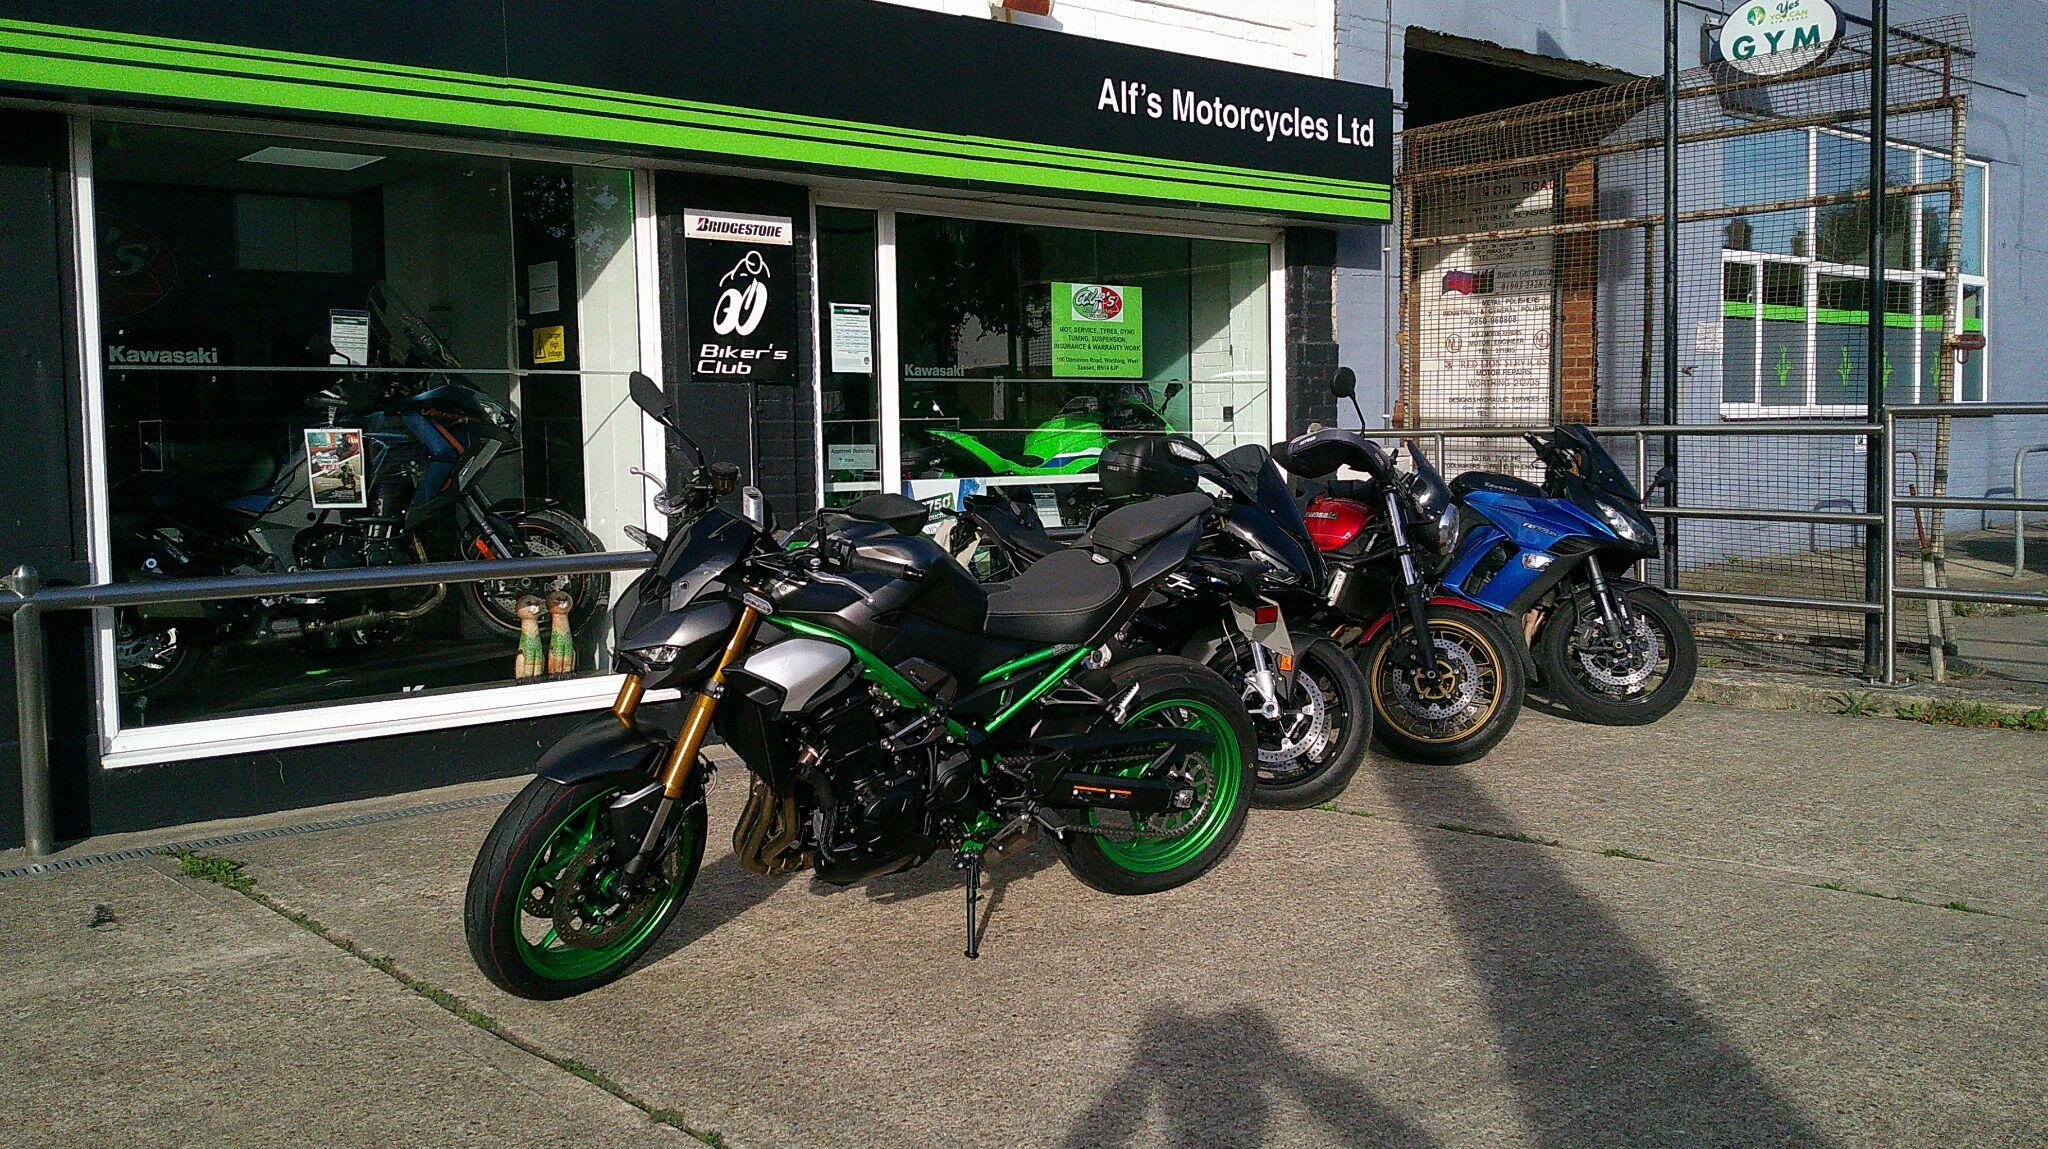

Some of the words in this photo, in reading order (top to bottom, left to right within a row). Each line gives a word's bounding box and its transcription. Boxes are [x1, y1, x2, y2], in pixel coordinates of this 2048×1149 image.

[1776, 0, 1800, 15] Yes
[1732, 24, 1820, 60] GYM
[1097, 77, 1163, 119] Alf's
[1172, 88, 1329, 142] Motorcycles
[1337, 113, 1374, 147] Ltd
[696, 217, 783, 238] BRIDGESTONE
[108, 345, 218, 363] Kawasaki
[700, 343, 789, 360] Biker's
[697, 360, 752, 374] Club
[904, 363, 965, 377] Kawasaki
[1504, 358, 1548, 367] SERVICES
[1468, 379, 1511, 388] WORTHING
